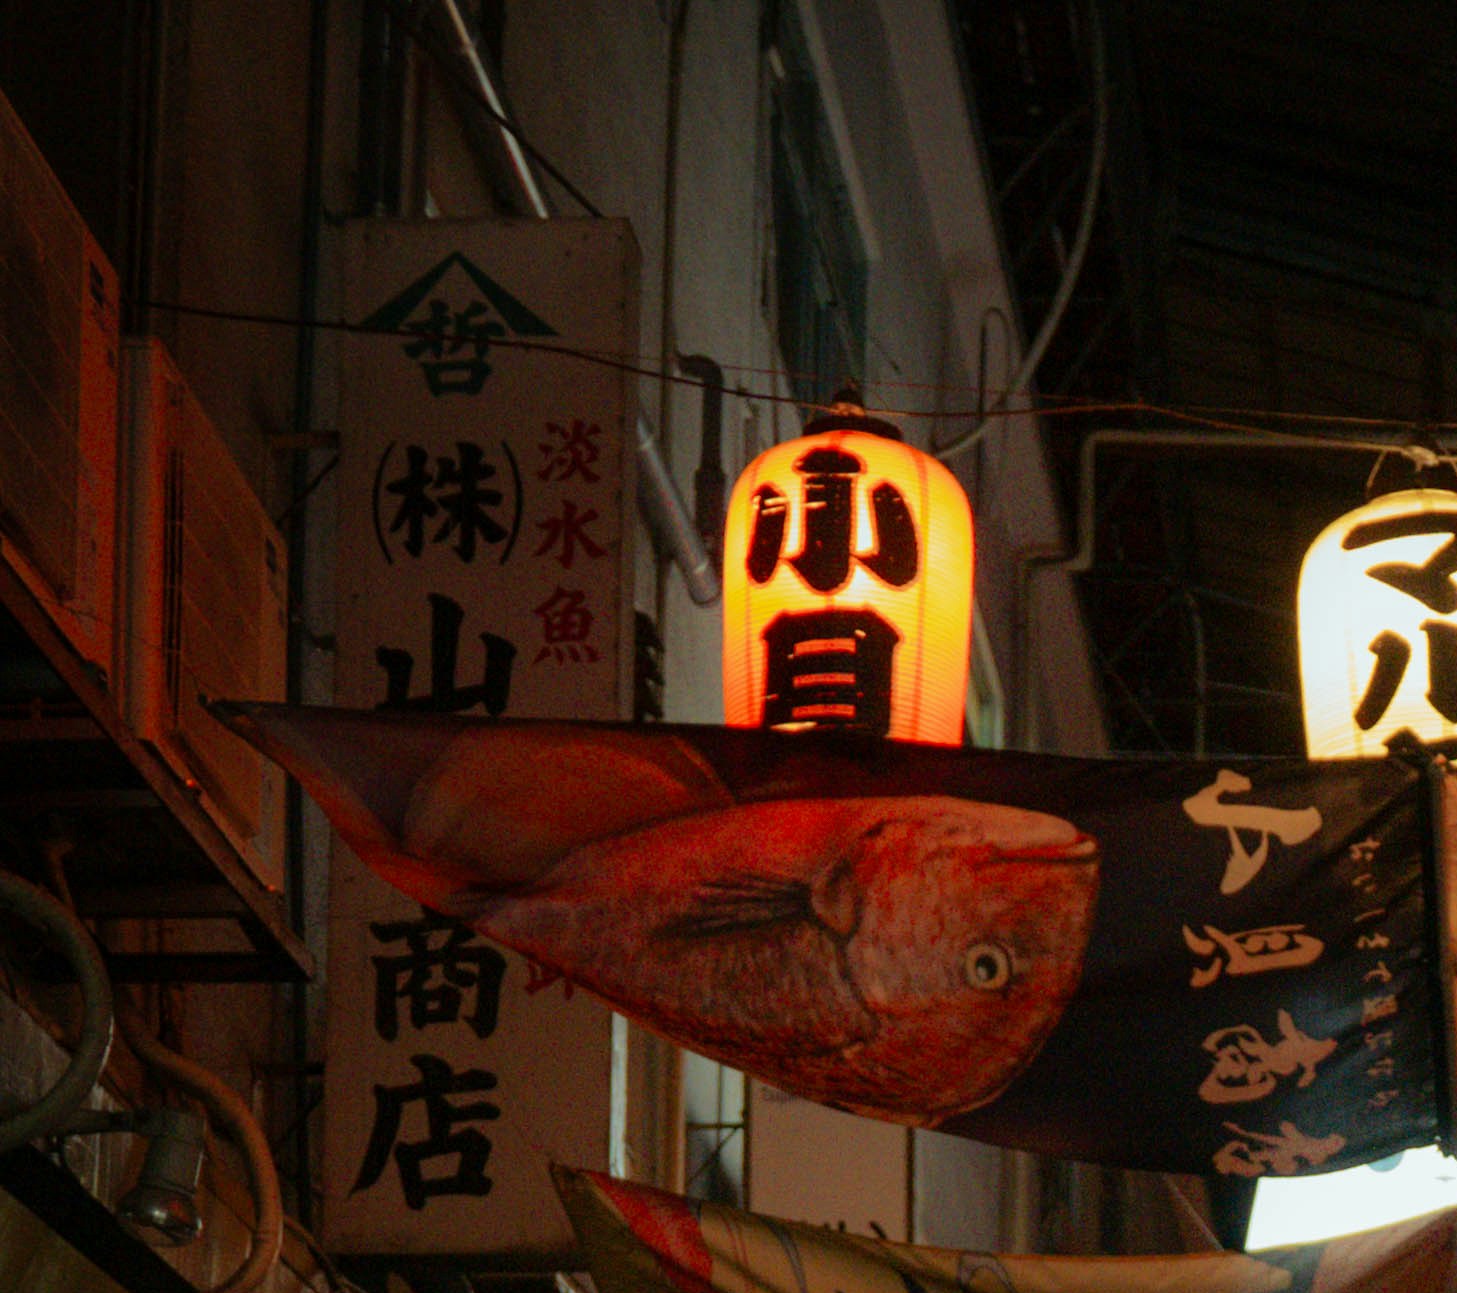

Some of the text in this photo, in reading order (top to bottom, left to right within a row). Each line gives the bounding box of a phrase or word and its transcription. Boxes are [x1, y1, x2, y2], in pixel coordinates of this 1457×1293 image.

[402, 298, 506, 398] 哲
[532, 418, 609, 666] 淡水魚
